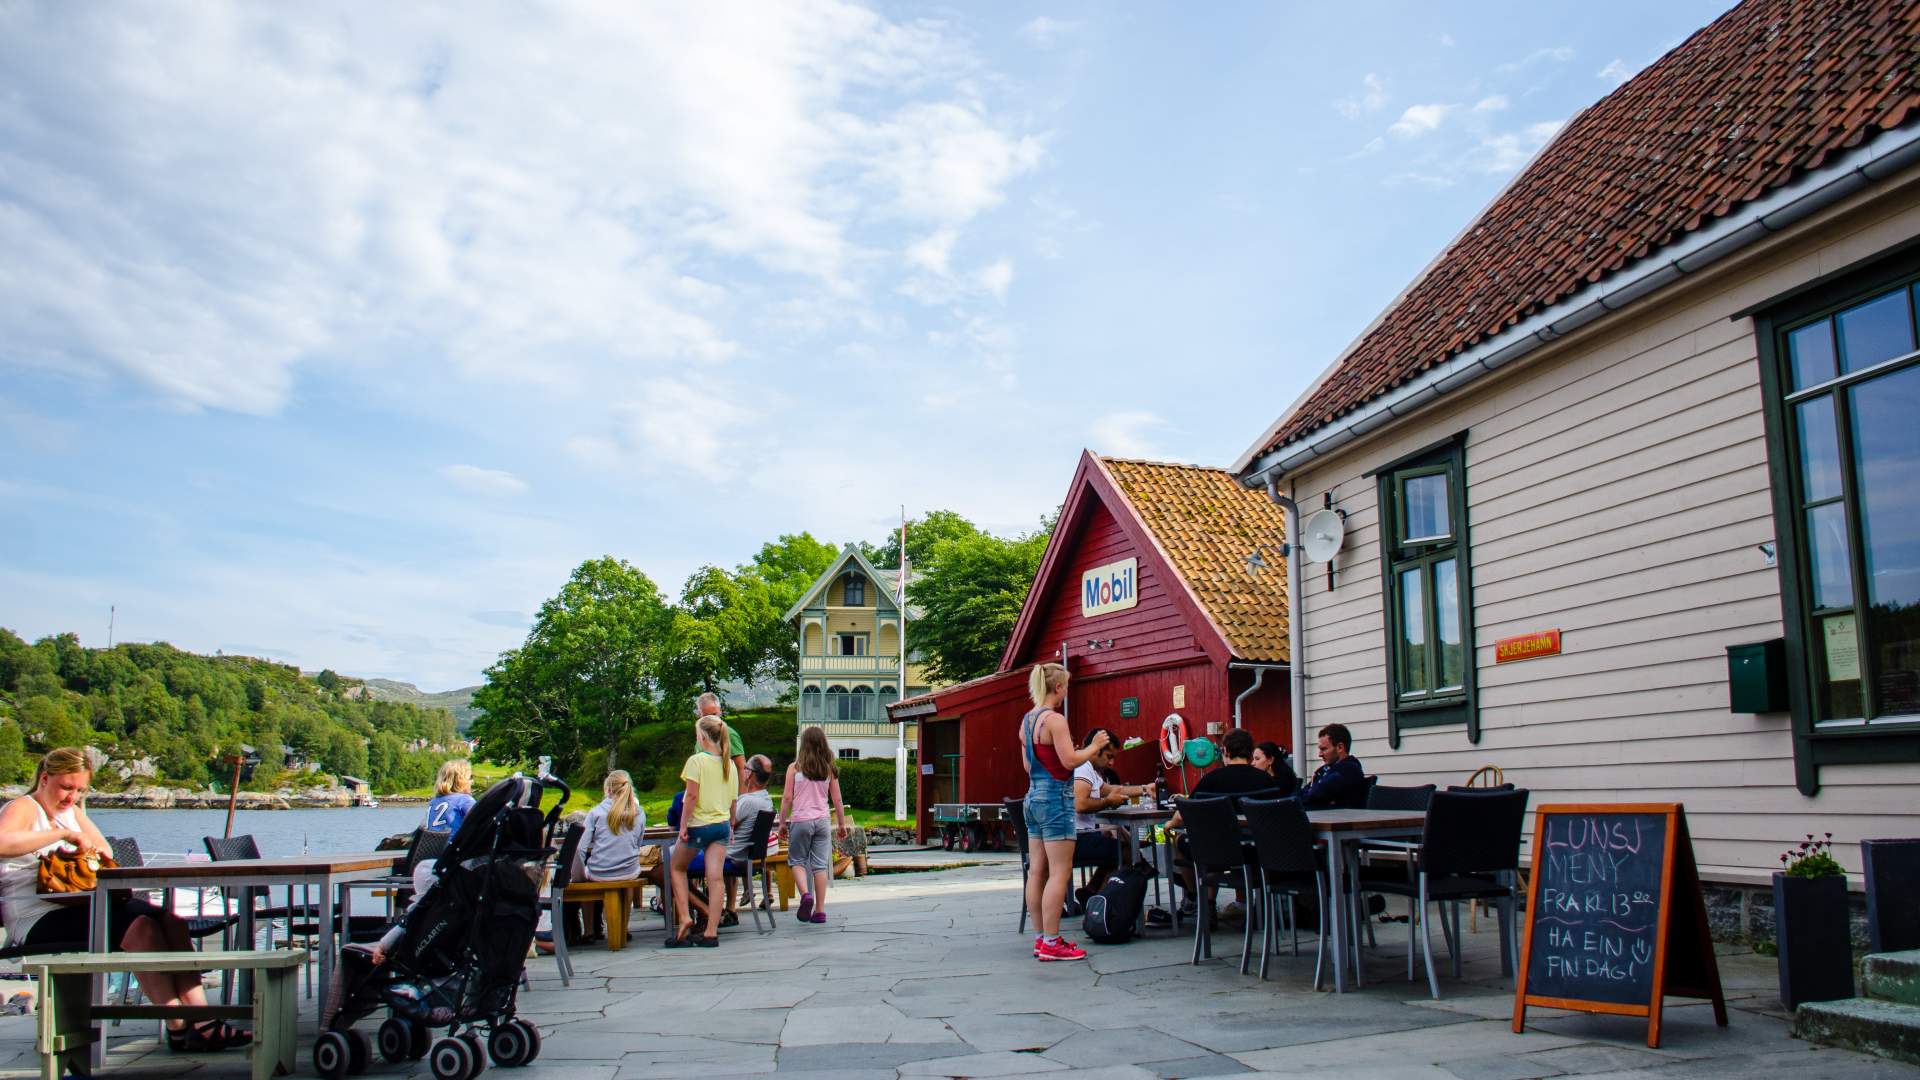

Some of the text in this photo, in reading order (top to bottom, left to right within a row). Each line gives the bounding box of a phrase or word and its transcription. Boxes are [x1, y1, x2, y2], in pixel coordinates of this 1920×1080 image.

[1086, 567, 1132, 608] Mobil
[1546, 818, 1641, 853] LUNSJ
[1547, 851, 1629, 888] MENY
[1543, 887, 1580, 912] FRA
[1585, 894, 1608, 912] KL
[1549, 927, 1622, 957] HA EIN
[1547, 956, 1636, 982] FIN DAG!
